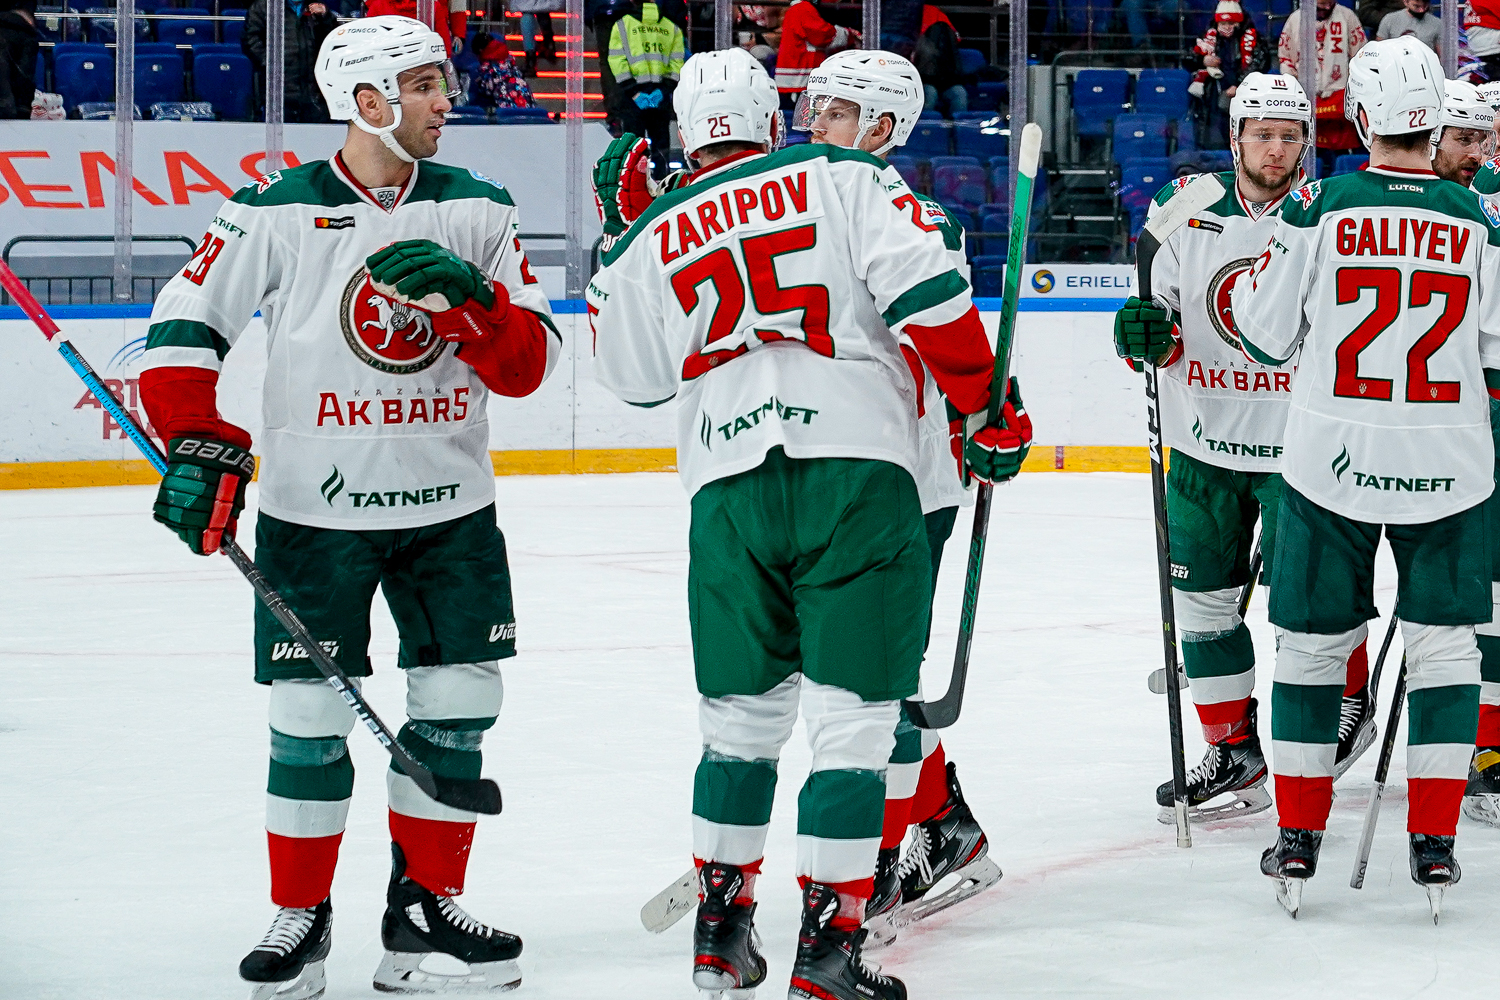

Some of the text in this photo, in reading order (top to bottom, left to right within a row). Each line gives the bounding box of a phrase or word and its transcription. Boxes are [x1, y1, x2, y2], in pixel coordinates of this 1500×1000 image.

[707, 115, 731, 139] 25
[1408, 109, 1428, 129] 22
[1388, 183, 1424, 193] LUTCH
[212, 216, 247, 239] ATNEFT
[653, 172, 808, 267] ZARIPOV
[1336, 217, 1471, 264] GALIYEV
[670, 223, 836, 381] 25
[1333, 266, 1472, 404] 22
[1233, 365, 1298, 393] BAR
[381, 387, 470, 426] BARS
[717, 395, 820, 442] TATNEFT
[174, 439, 255, 475] BAUE
[1205, 438, 1284, 459] TATNEF
[348, 482, 461, 508] TATNEFT
[1352, 472, 1456, 493] TATNEFT
[328, 674, 393, 747] BAUER
